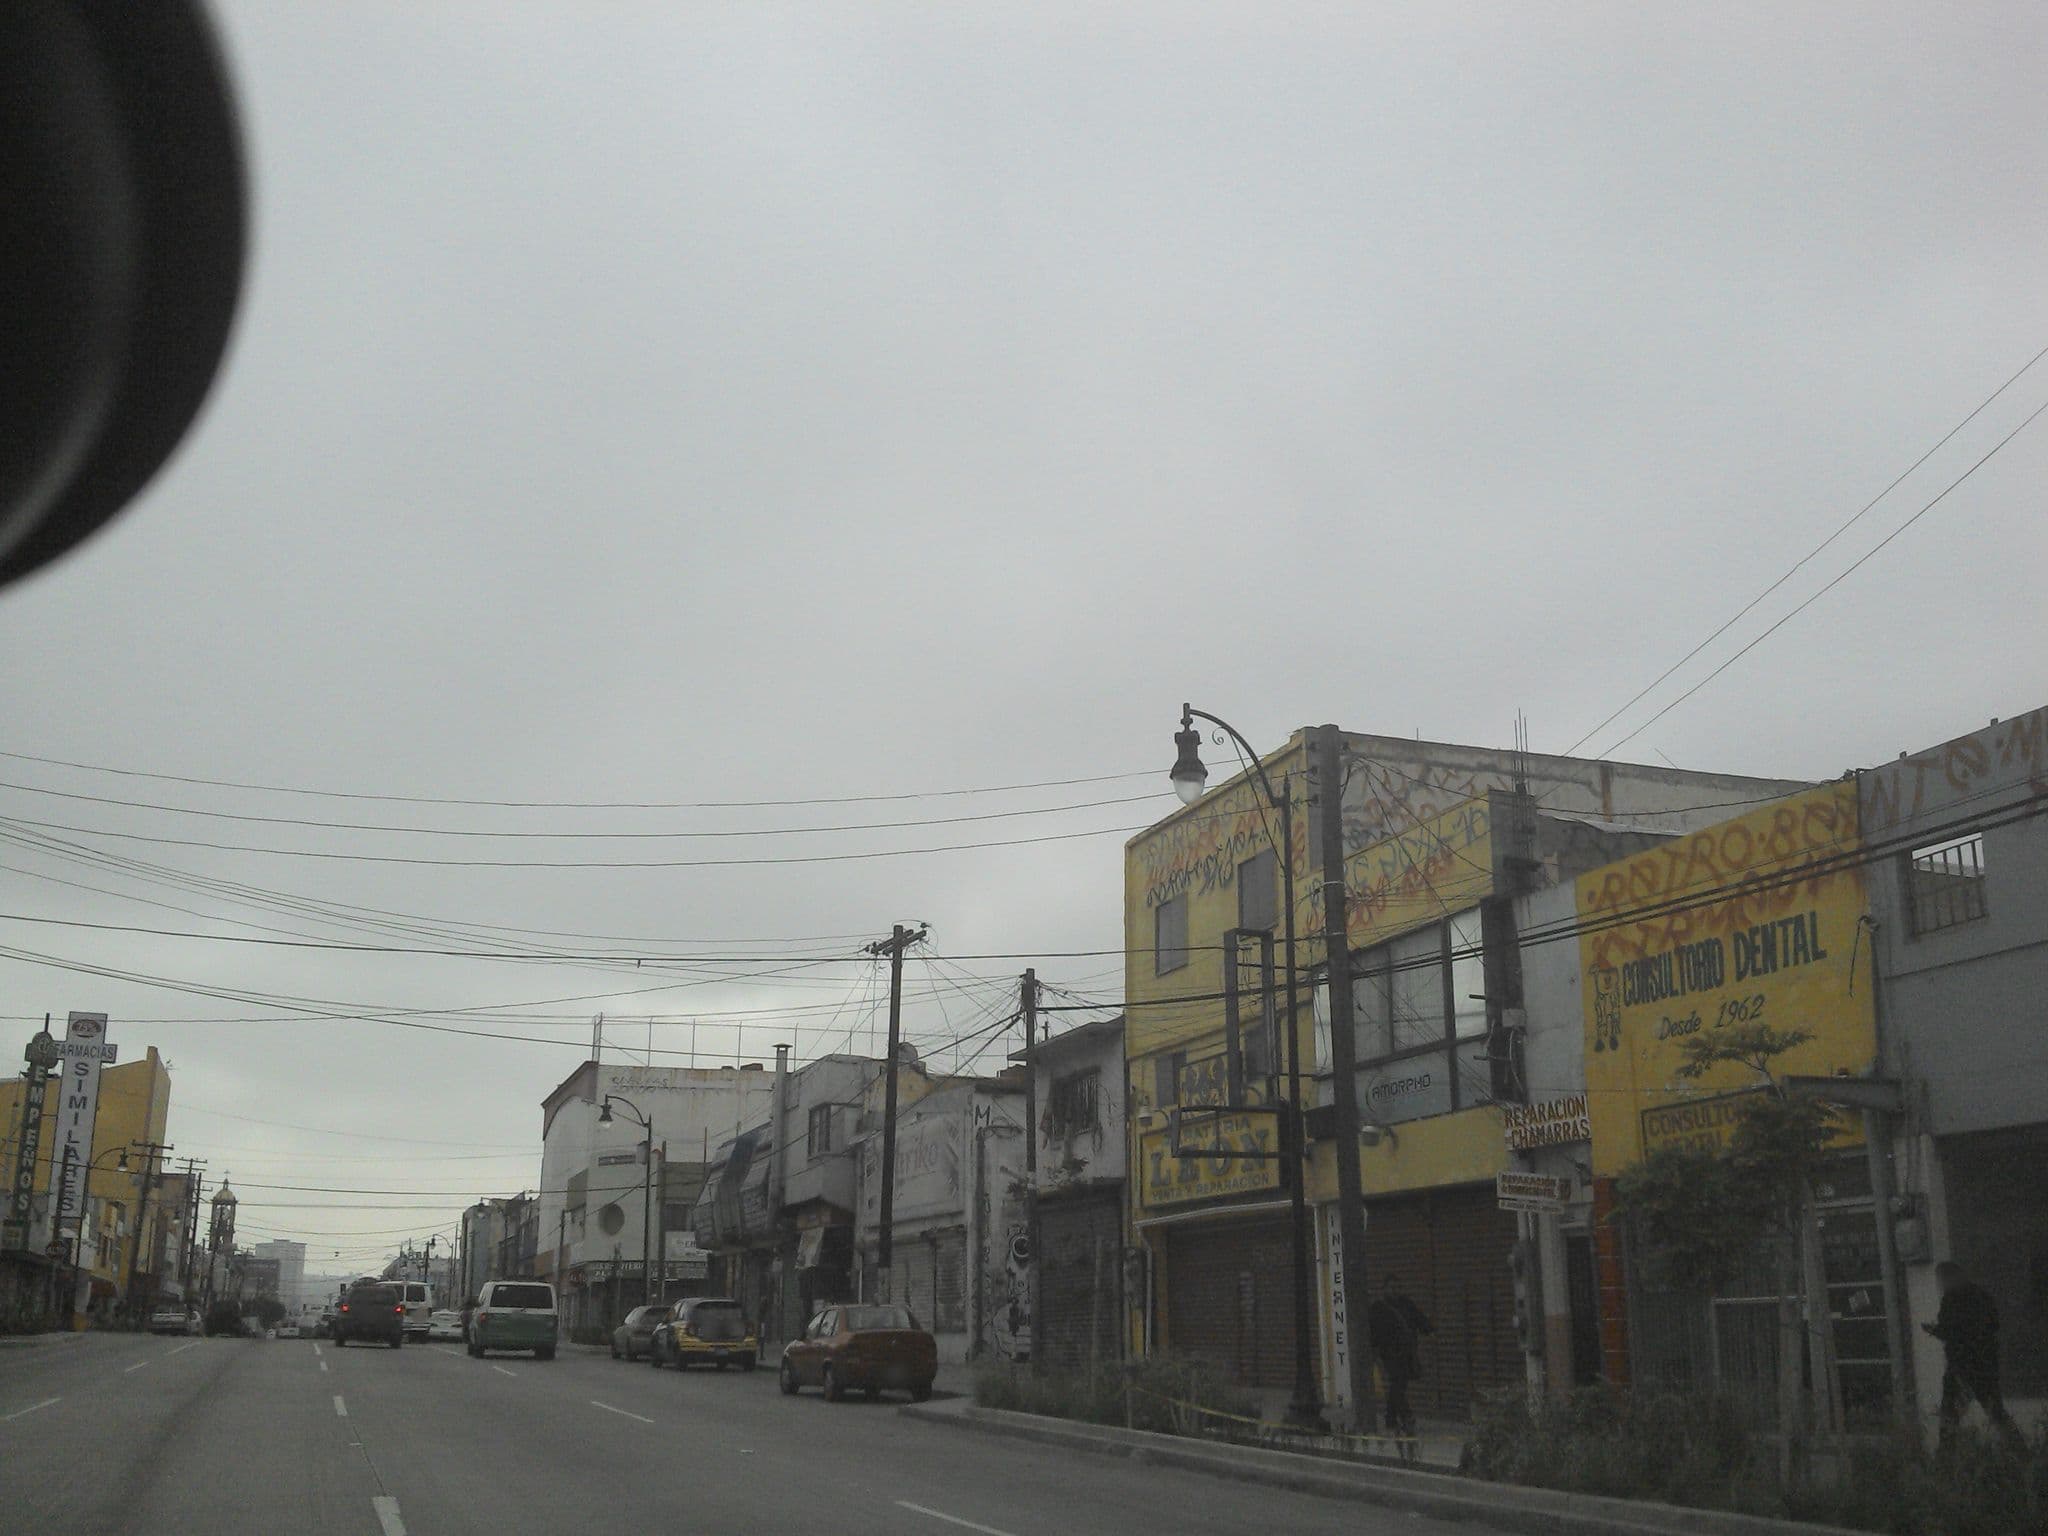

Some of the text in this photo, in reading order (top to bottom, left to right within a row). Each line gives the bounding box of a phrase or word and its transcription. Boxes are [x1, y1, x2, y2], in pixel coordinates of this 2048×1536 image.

[1622, 936, 1725, 1008] CONSULTORIO
[1733, 911, 1827, 982] DENTAL
[1659, 994, 1765, 1040] Desde 1962
[54, 1042, 115, 1060] FARMACIAS
[1371, 1074, 1432, 1100] AMORPHO
[1504, 1096, 1586, 1129] REPARACION
[60, 1062, 89, 1211] SIMILARES
[1511, 1119, 1590, 1149] CHAMARRAS
[1330, 1214, 1347, 1367] INTERNET
